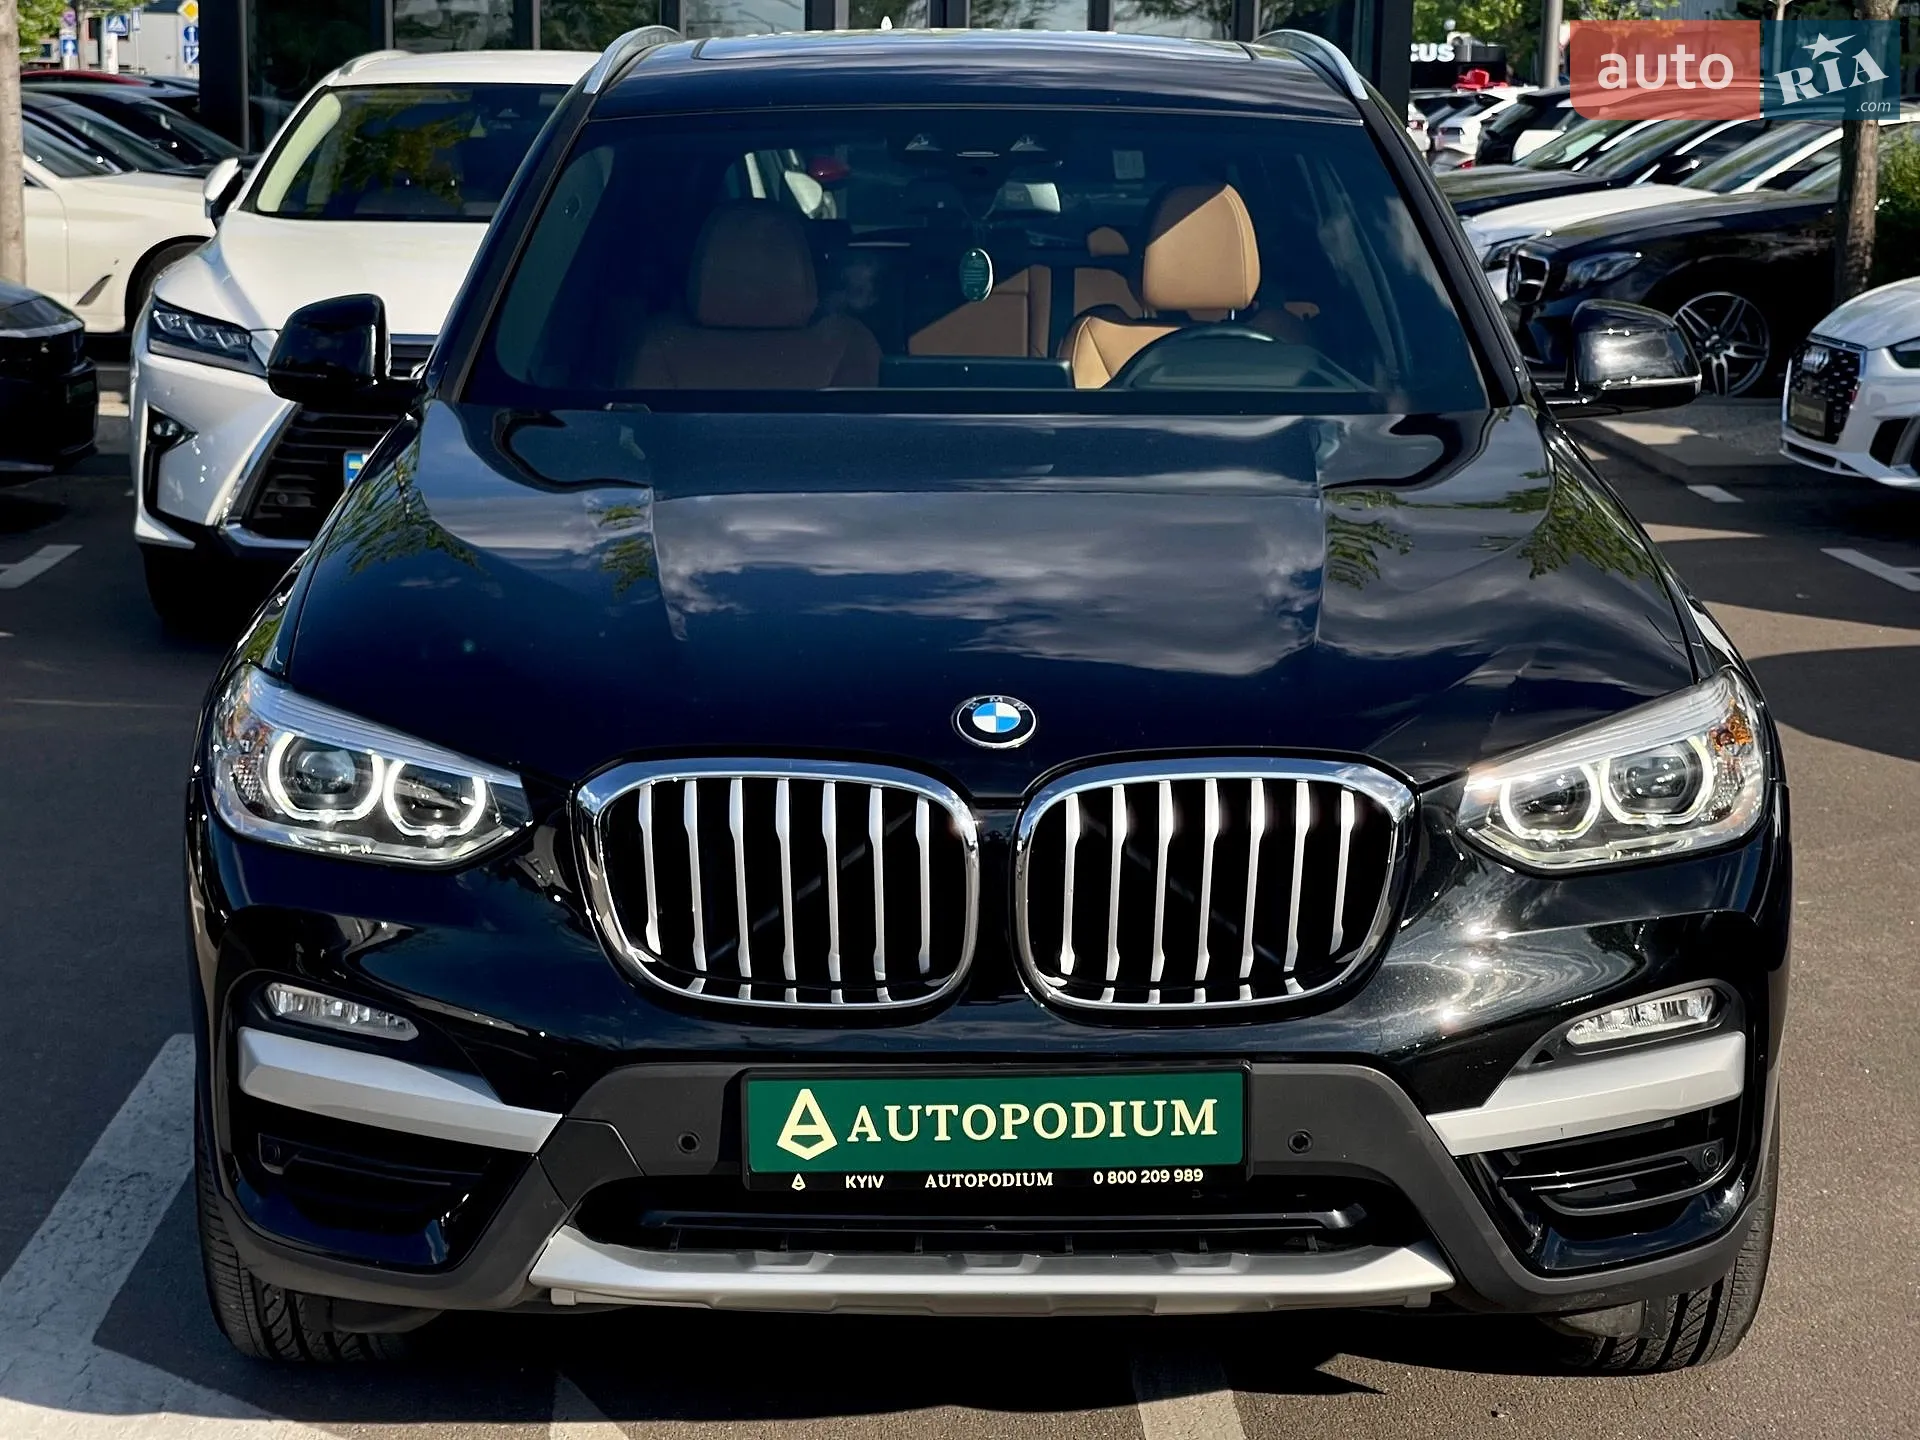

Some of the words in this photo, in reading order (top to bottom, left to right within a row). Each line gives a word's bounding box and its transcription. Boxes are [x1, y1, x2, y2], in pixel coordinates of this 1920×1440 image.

[846, 1098, 1218, 1143] AUTOPODIUM
[845, 1174, 885, 1189] KYIV
[924, 1171, 1054, 1189] AUTOPODIUM
[1093, 1172, 1103, 1185] 0
[1107, 1171, 1136, 1185] 800
[1140, 1170, 1170, 1184] 209
[1173, 1168, 1203, 1183] 989
